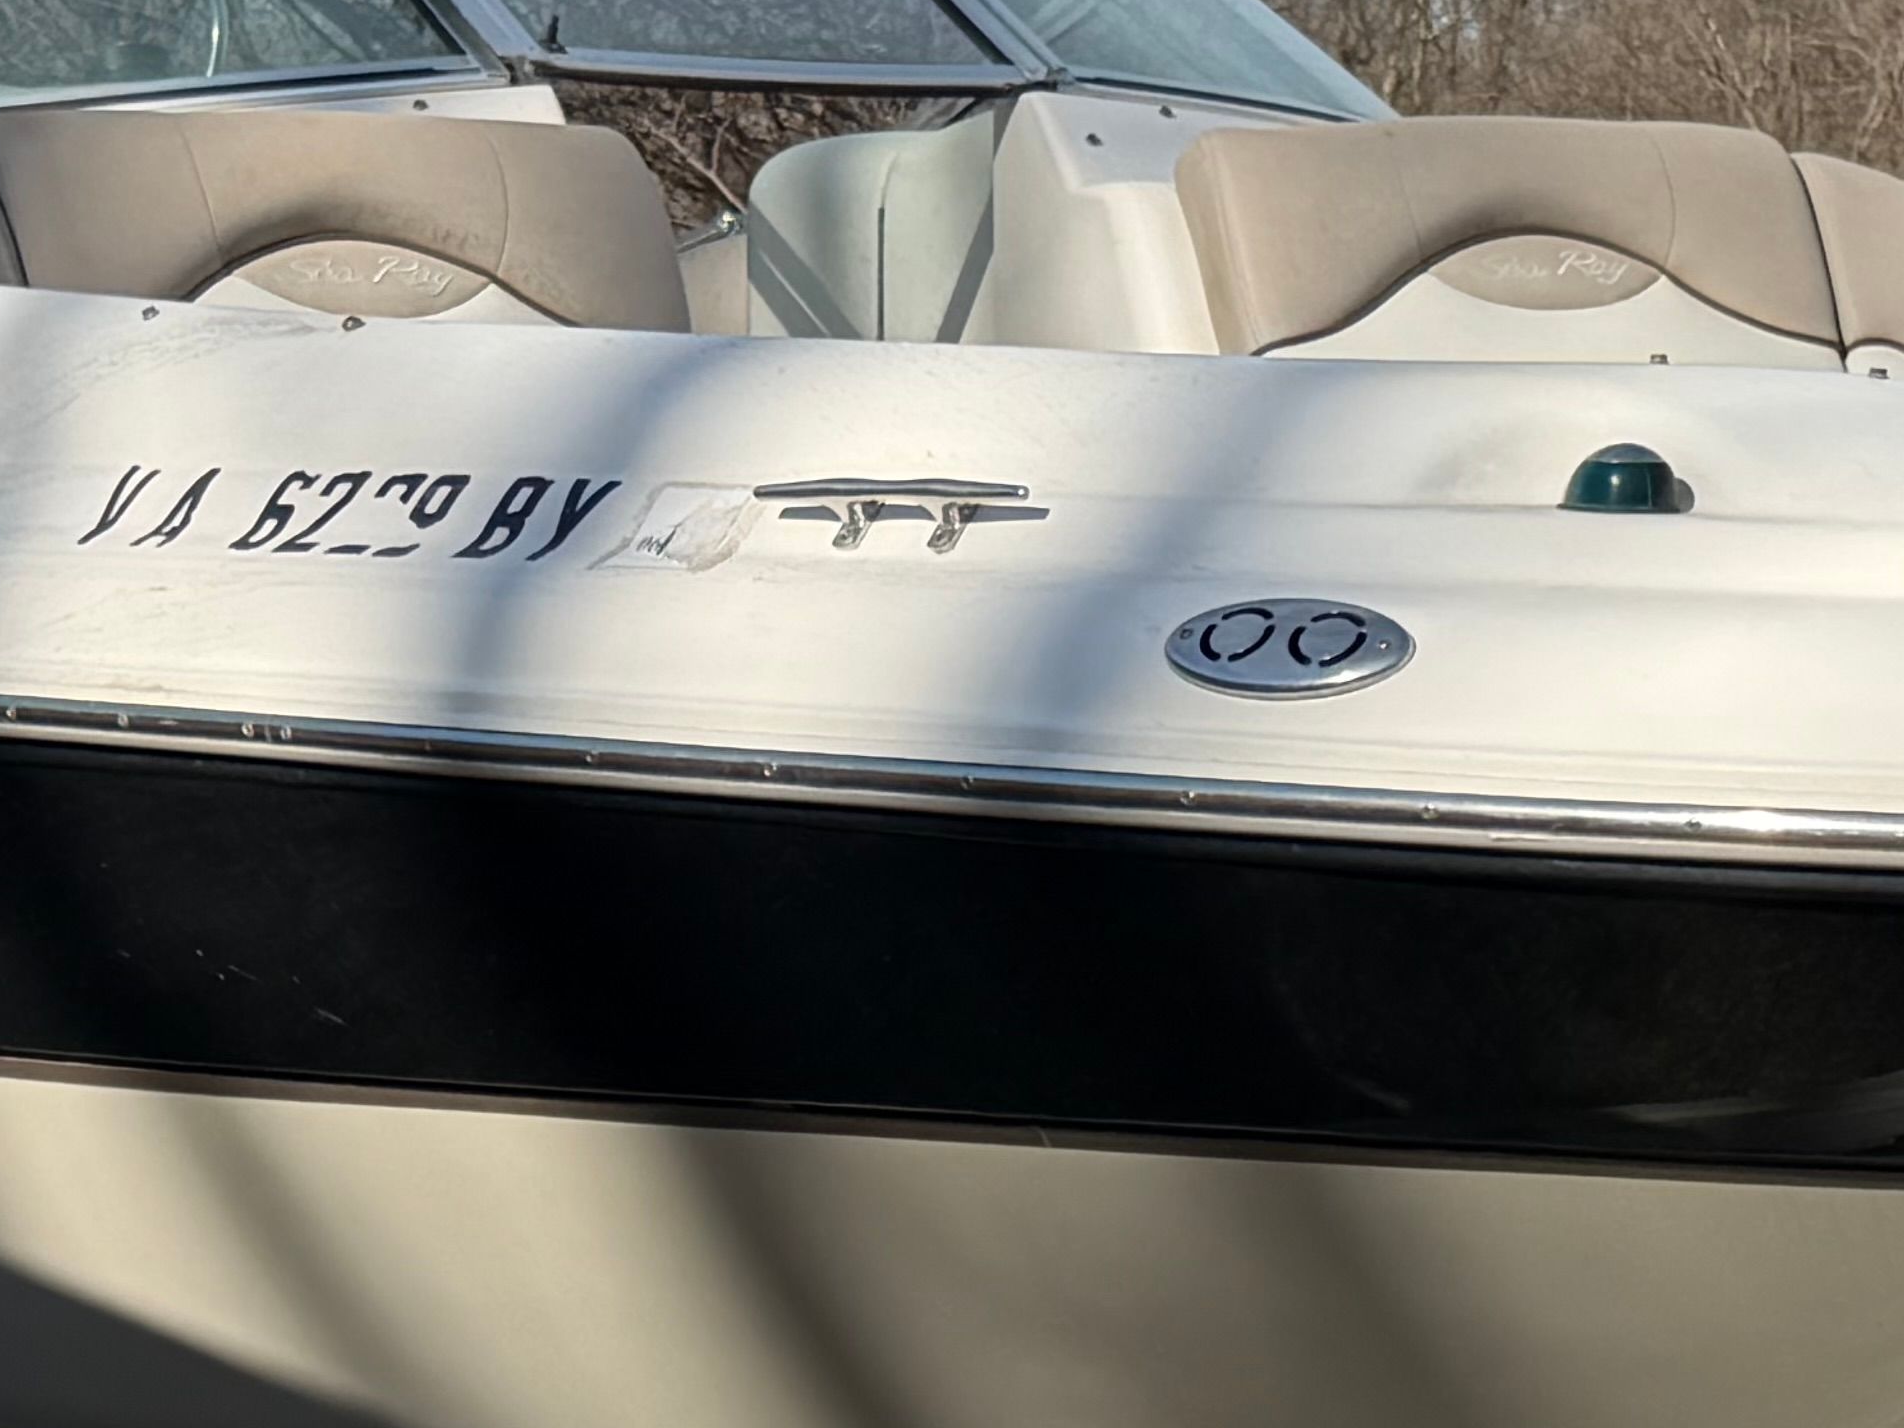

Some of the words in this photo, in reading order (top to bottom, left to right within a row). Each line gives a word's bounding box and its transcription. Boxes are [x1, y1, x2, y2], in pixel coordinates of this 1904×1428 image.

[372, 256, 454, 298] Ray
[1557, 250, 1628, 285] Ray
[77, 465, 221, 547] VA
[450, 474, 623, 560] BY
